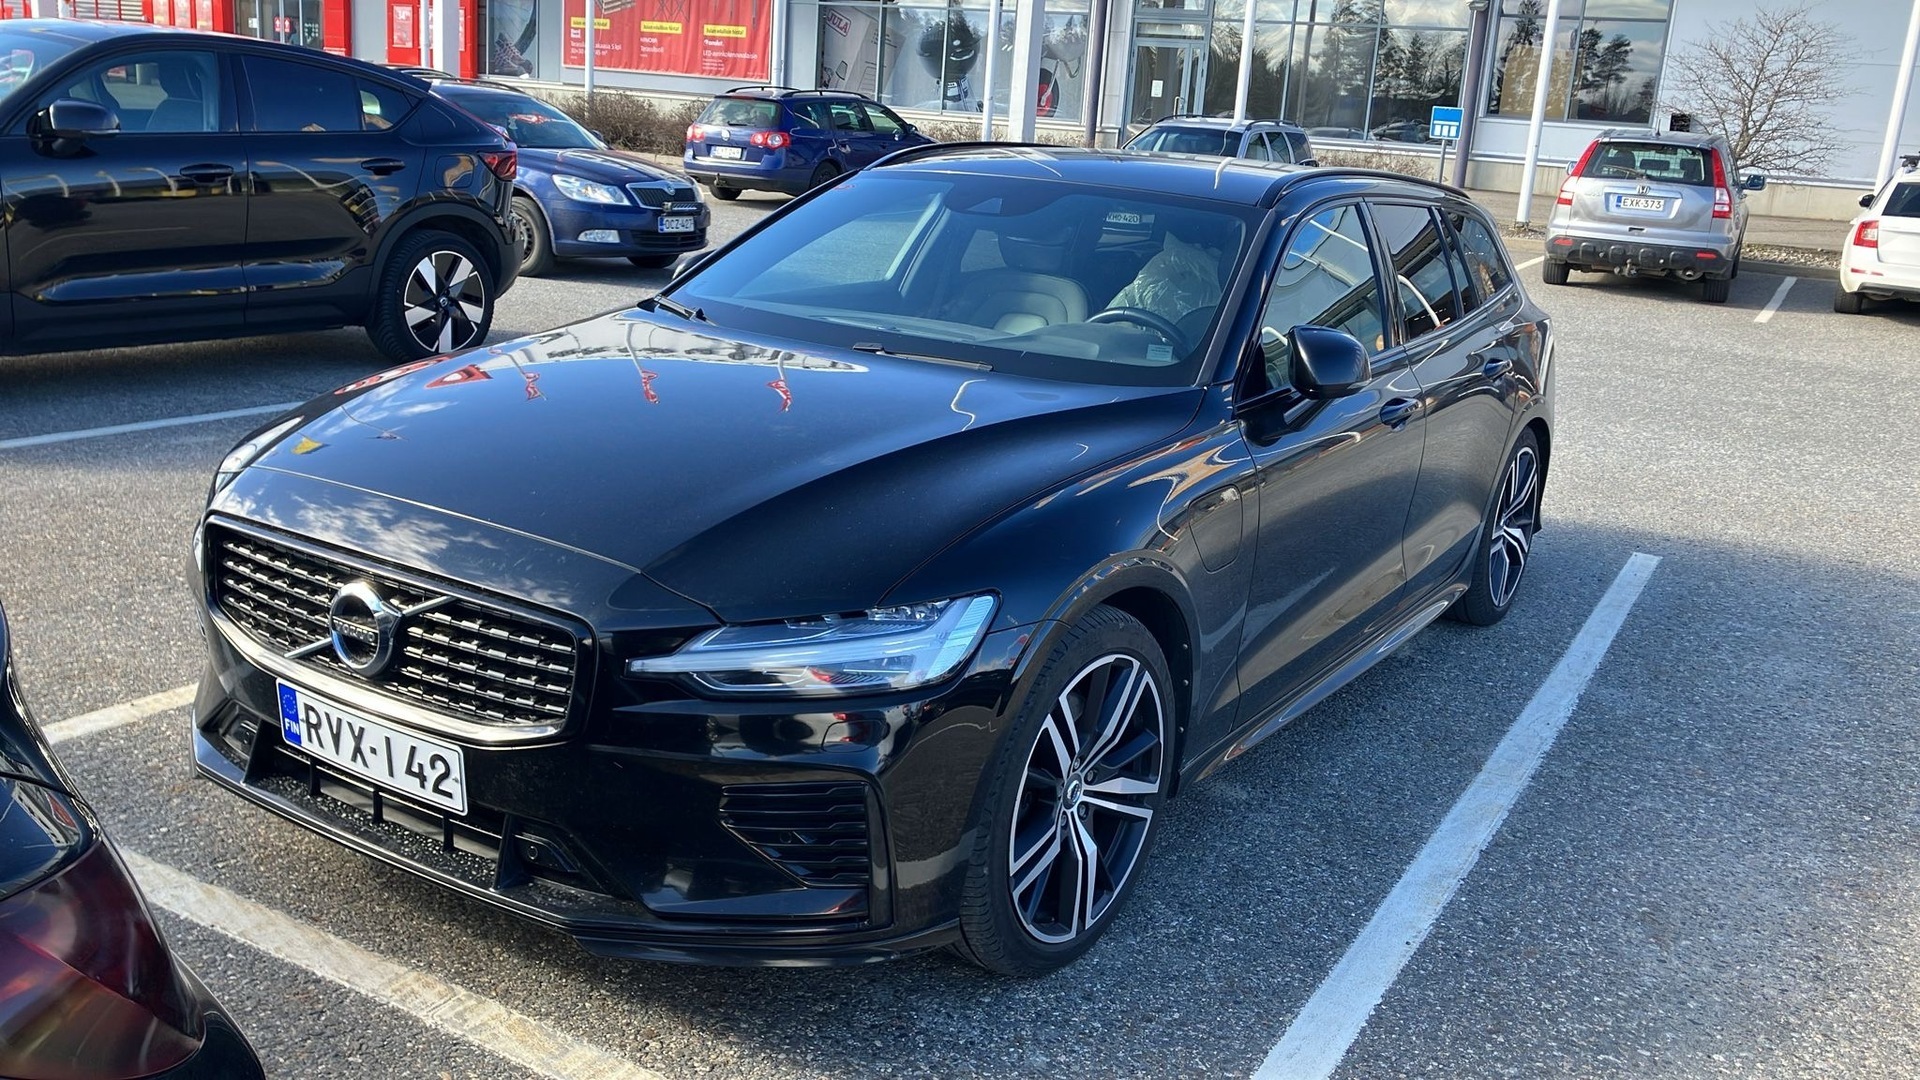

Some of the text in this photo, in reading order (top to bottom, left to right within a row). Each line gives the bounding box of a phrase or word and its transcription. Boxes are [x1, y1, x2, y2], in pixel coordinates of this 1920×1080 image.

[828, 10, 851, 34] JULA
[1622, 198, 1662, 210] EXK-373
[333, 619, 375, 642] VOLVO
[284, 717, 300, 736] FIN
[303, 702, 453, 799] RVX-142
